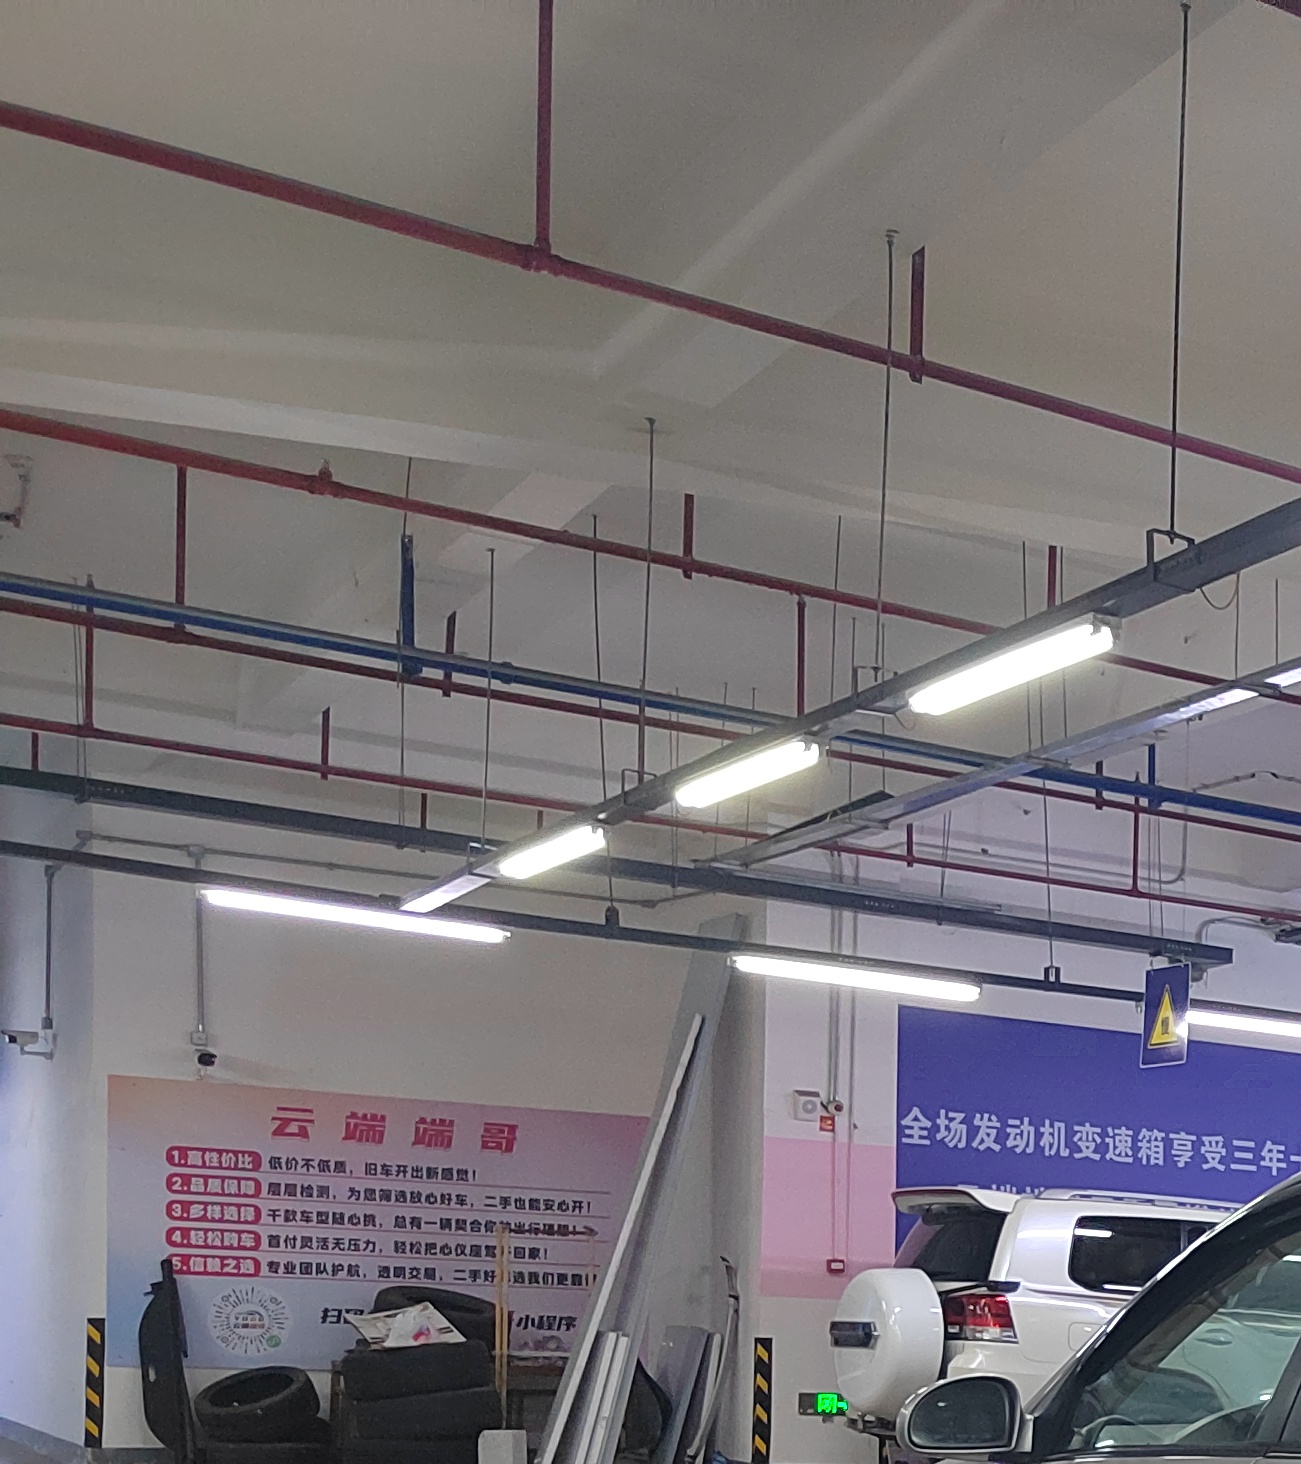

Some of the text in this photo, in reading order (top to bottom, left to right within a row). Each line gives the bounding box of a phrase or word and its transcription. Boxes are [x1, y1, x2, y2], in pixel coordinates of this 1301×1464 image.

[270, 1106, 519, 1155] 云端端哥
[171, 1149, 254, 1169] 1.高性价比
[171, 1203, 255, 1222] 3.多样选择
[171, 1230, 255, 1248] 4.轻松购车
